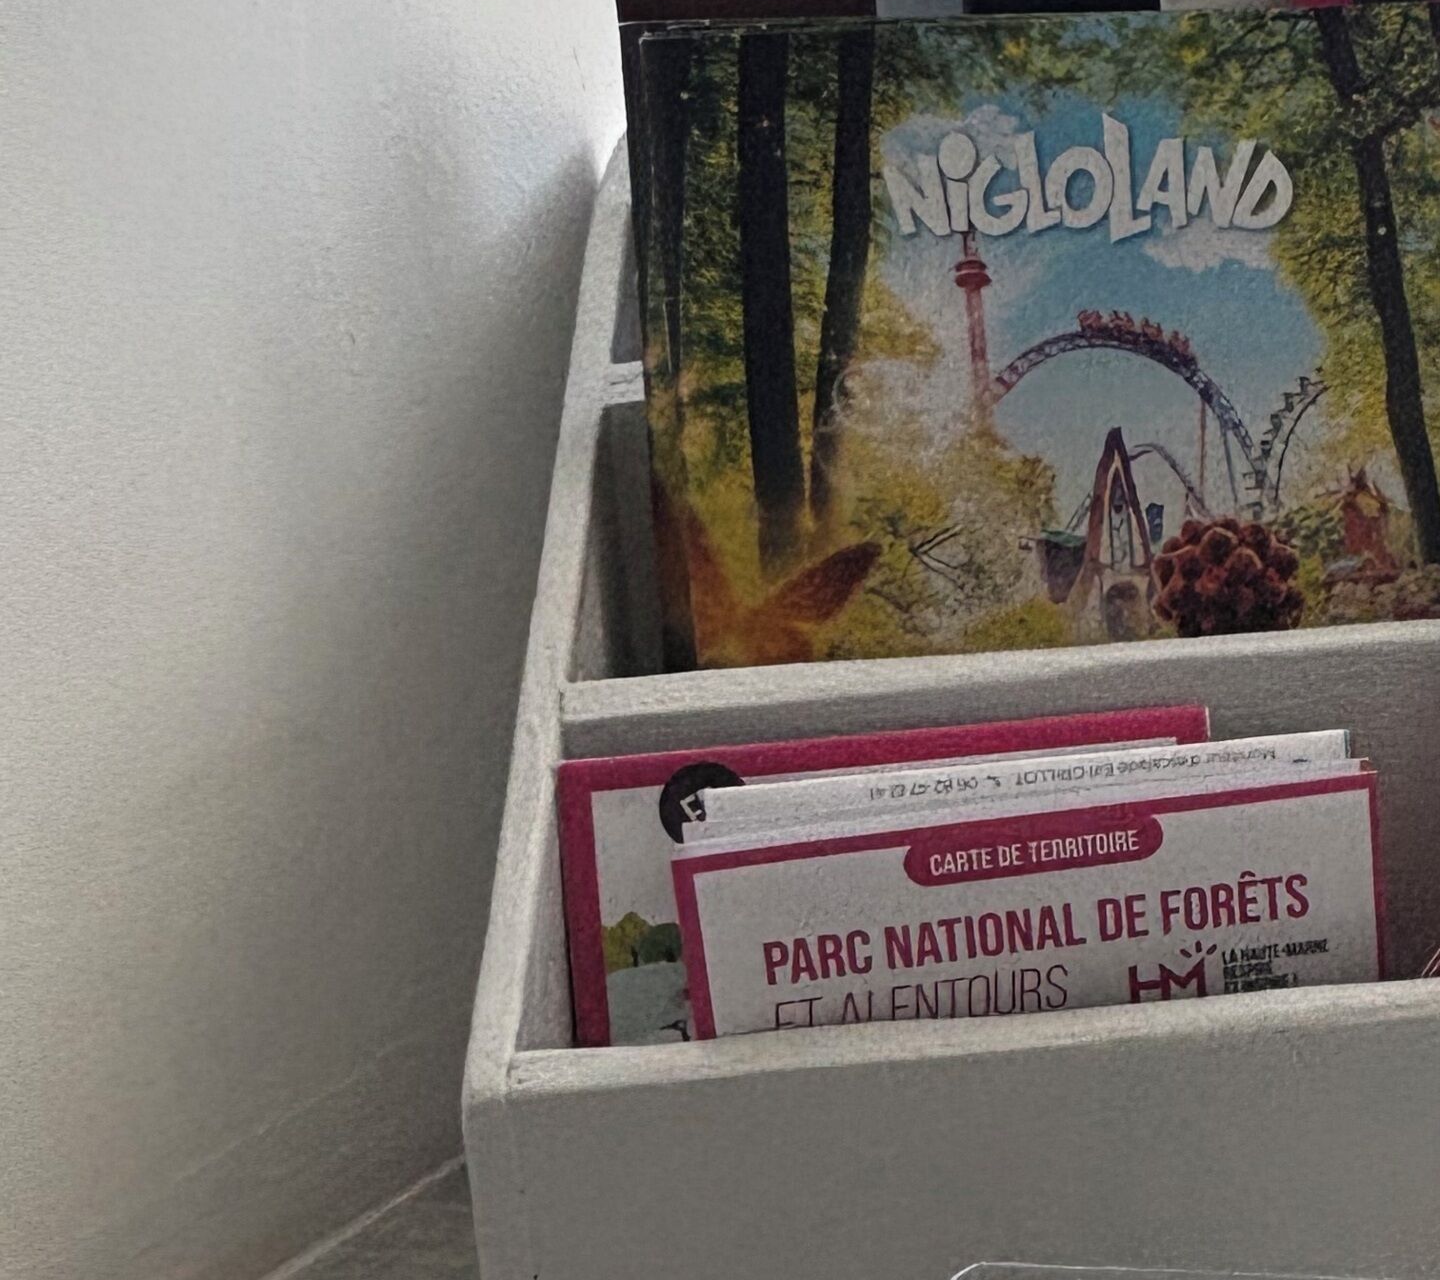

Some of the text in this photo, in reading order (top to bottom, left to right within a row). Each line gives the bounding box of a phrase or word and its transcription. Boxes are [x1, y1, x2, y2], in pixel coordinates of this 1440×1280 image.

[929, 829, 1142, 877] CARTE DE TERRITOIRE
[762, 870, 1311, 986] PARC NATIONAL DE FORÊTS
